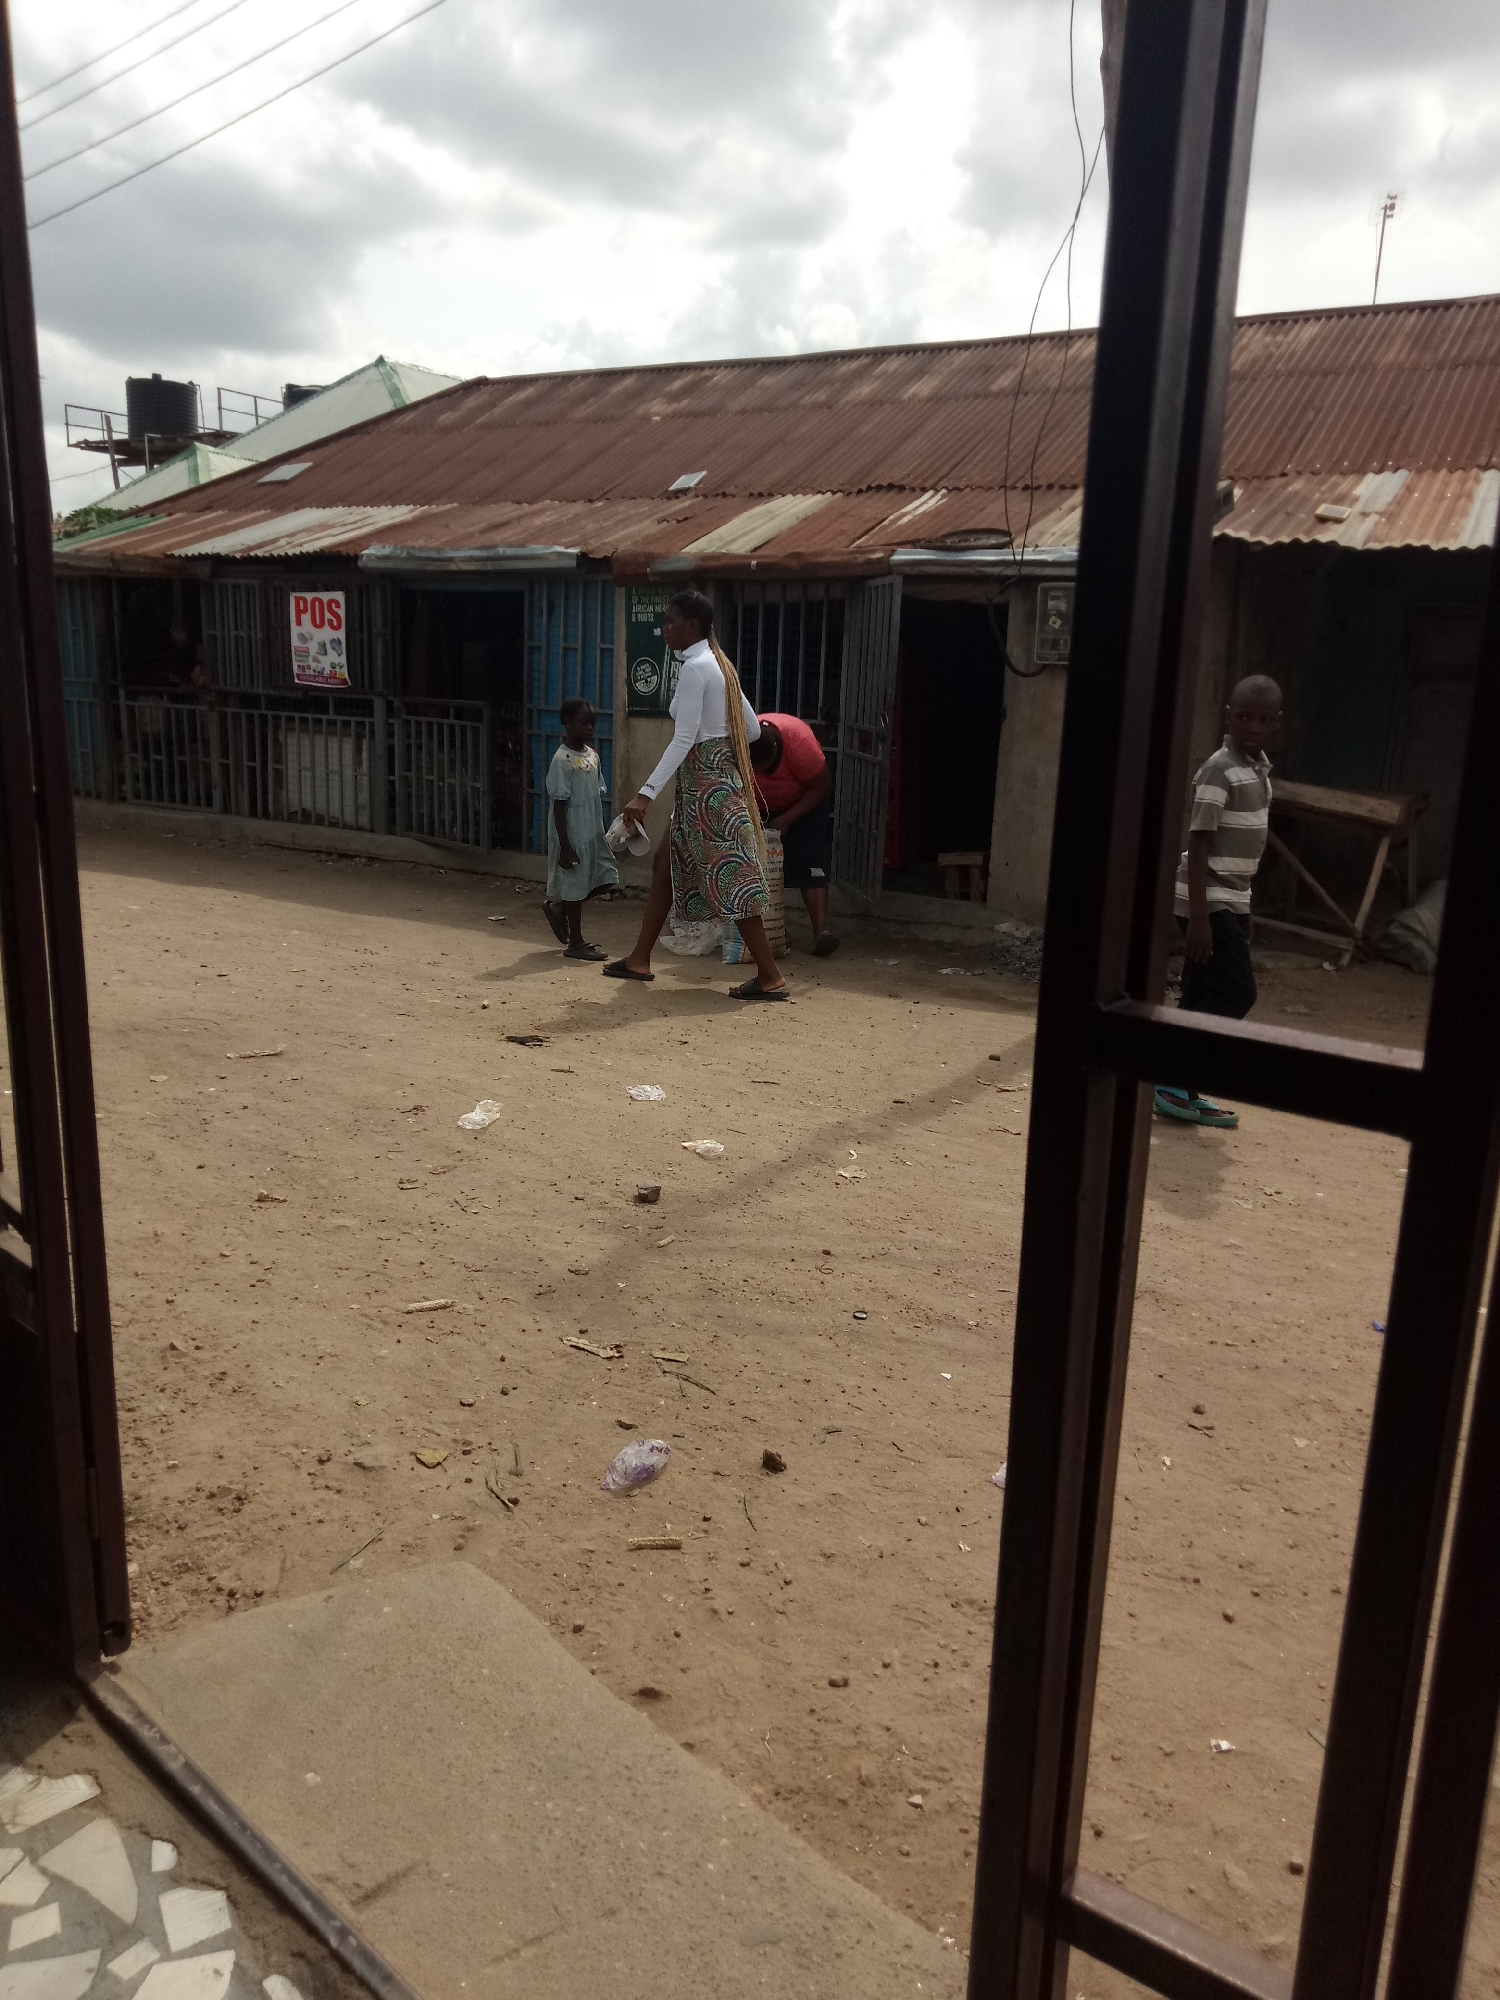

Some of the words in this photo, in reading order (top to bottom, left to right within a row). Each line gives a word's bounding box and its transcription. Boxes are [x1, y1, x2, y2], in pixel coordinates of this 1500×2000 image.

[640, 595, 649, 604] THE
[651, 595, 669, 604] FINEST
[294, 595, 342, 631] POS
[632, 604, 654, 613] AFRICAN
[655, 604, 666, 613] HER
[637, 612, 655, 622] ROOTS
[299, 674, 327, 684] AVAILABLE
